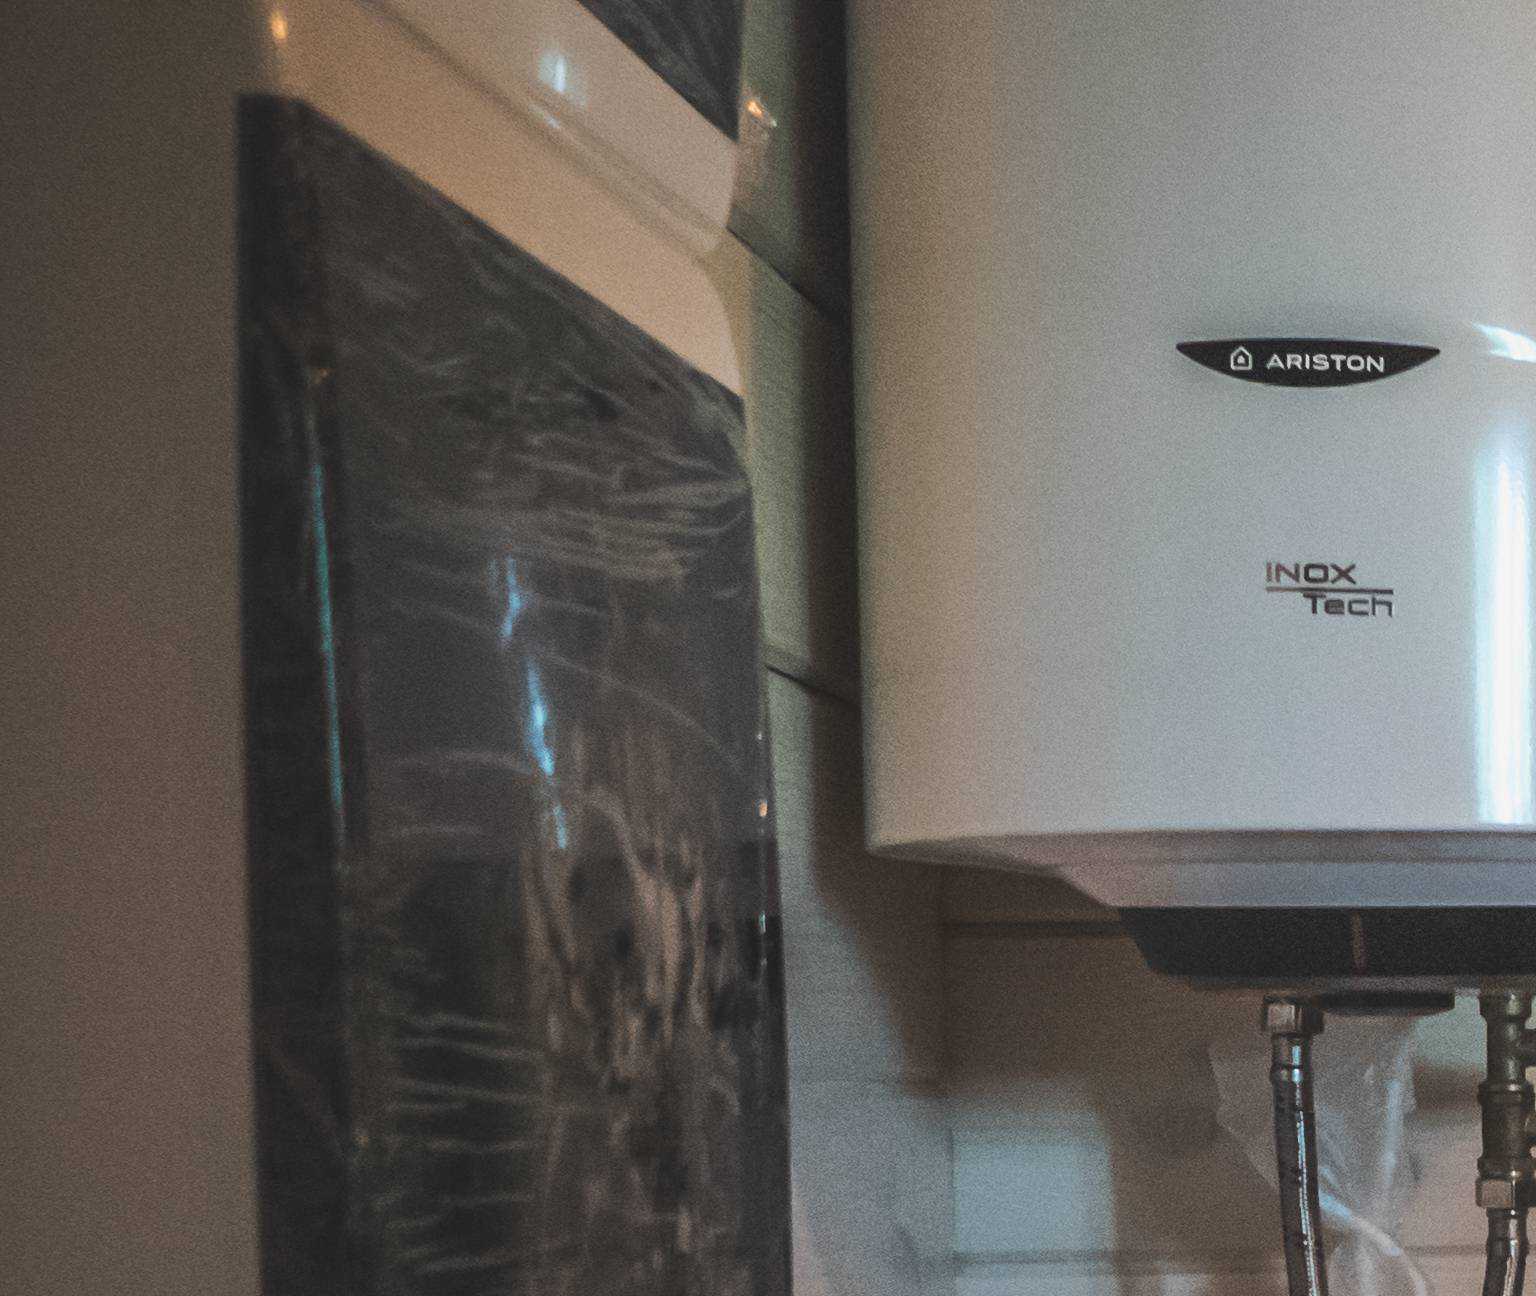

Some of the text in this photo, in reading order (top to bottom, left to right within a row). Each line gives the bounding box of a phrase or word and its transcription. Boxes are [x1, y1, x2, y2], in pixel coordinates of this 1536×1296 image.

[1265, 353, 1386, 374] ARISTON
[1265, 561, 1357, 585] INOX
[1302, 591, 1394, 617] Tech
